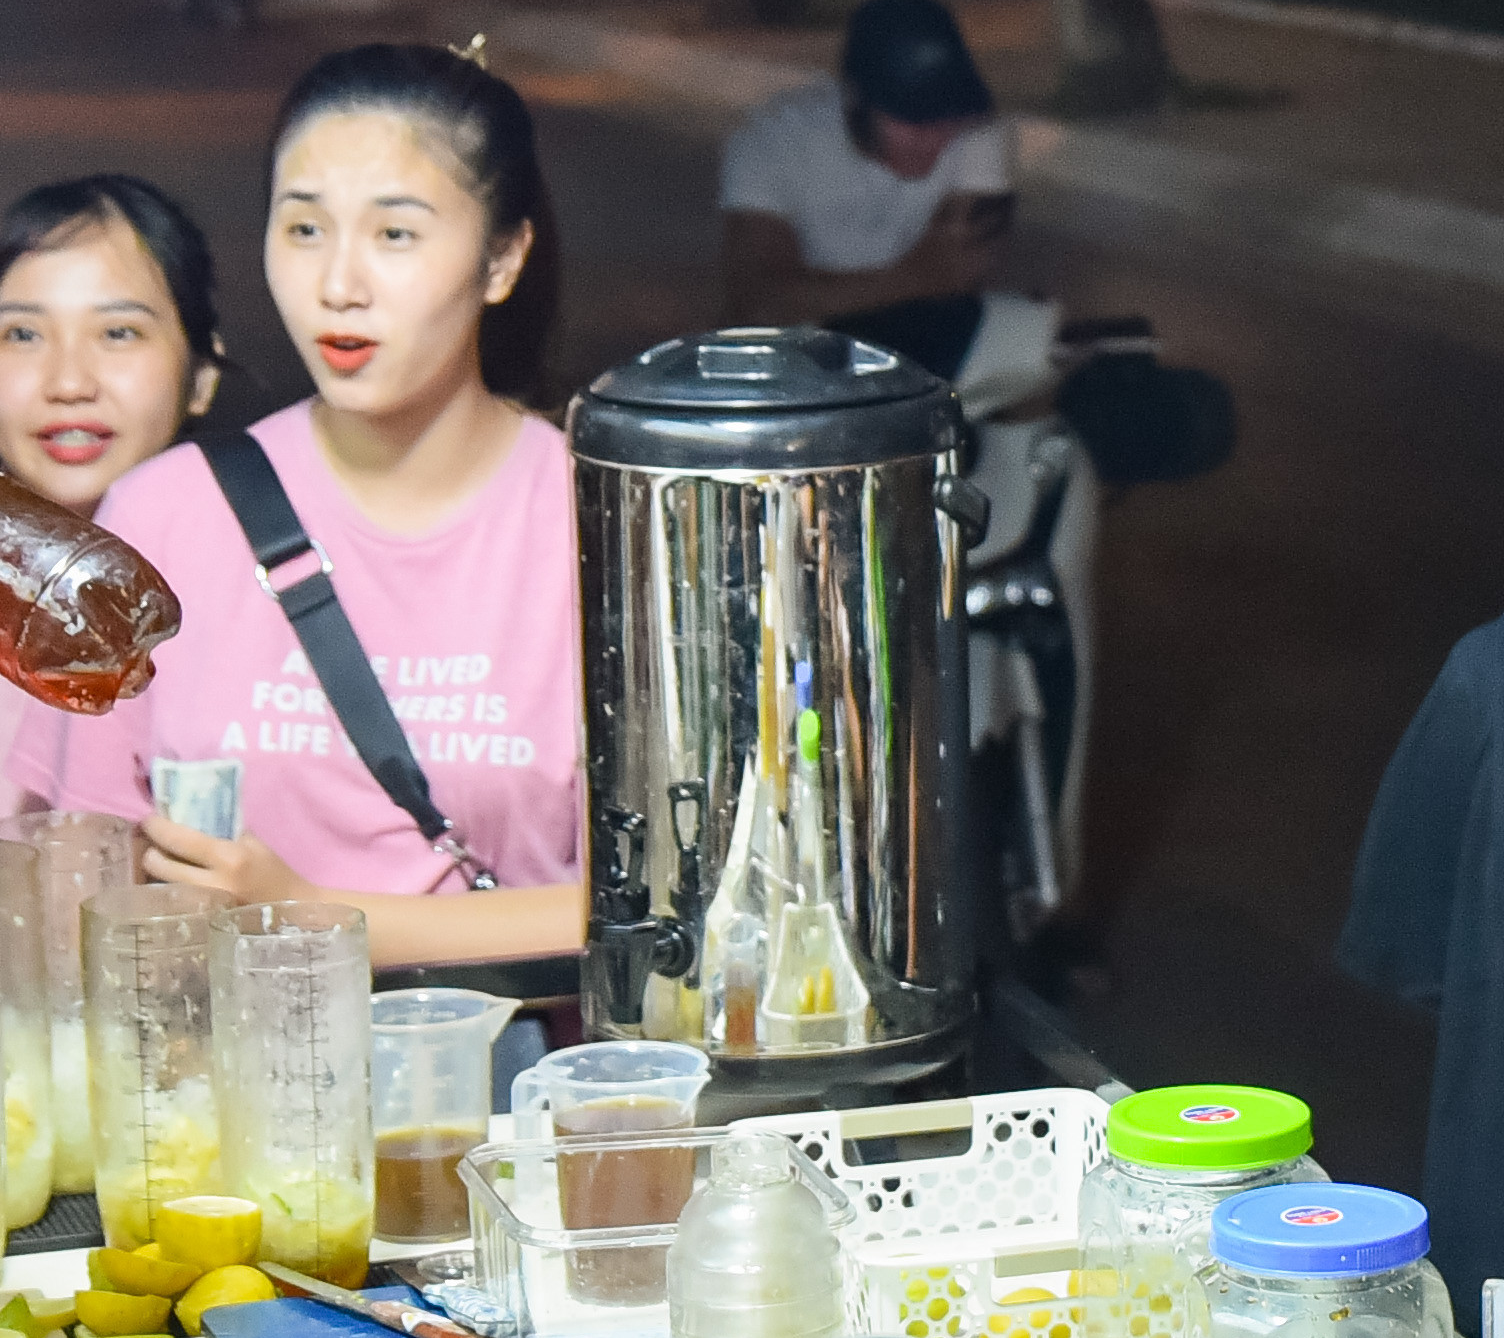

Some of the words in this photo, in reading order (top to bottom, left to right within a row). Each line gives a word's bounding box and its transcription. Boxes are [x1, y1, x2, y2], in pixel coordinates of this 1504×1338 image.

[281, 648, 310, 677] A
[397, 653, 492, 687] LIVED
[252, 680, 328, 716] FOR
[472, 691, 508, 724] IS
[220, 720, 248, 751] A
[259, 720, 331, 755] LIFE
[429, 731, 536, 767] LIVED
